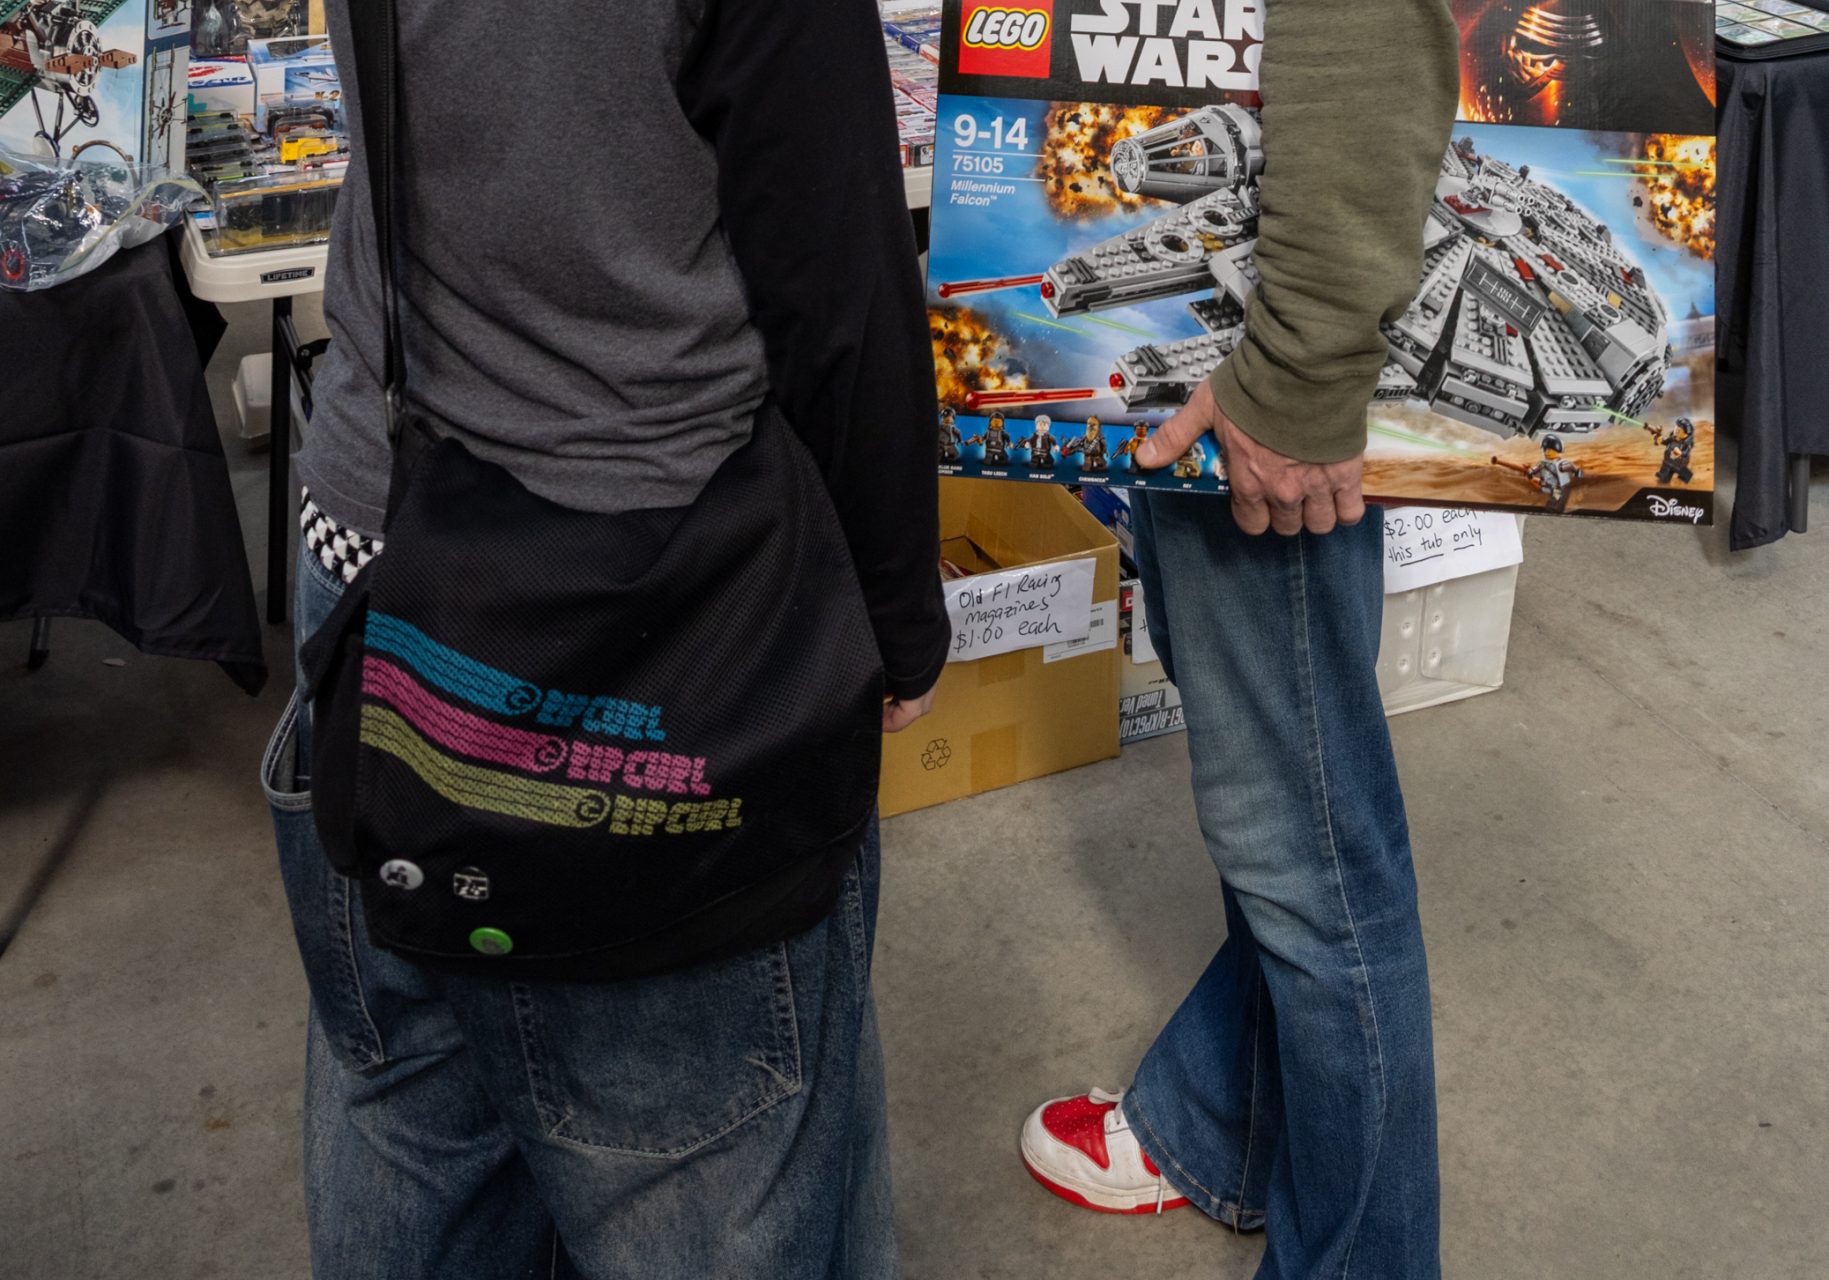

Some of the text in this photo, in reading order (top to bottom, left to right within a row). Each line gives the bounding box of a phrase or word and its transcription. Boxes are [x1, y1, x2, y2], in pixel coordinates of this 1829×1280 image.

[966, 7, 1049, 47] LEGO
[954, 114, 1028, 150] 9-14
[952, 154, 1004, 173] 75105
[950, 180, 1016, 195] Millennium
[267, 269, 309, 281] LIFETIME
[1384, 507, 1477, 540] $2.00 each
[1388, 524, 1482, 563] this tub only
[959, 588, 983, 608] Old
[1016, 573, 1063, 598] Racing
[953, 614, 1063, 654] $1.00 each
[1120, 689, 1165, 715] Tuned Ver.
[567, 740, 711, 795] RIP CURL
[610, 794, 742, 835] RIP CURL
